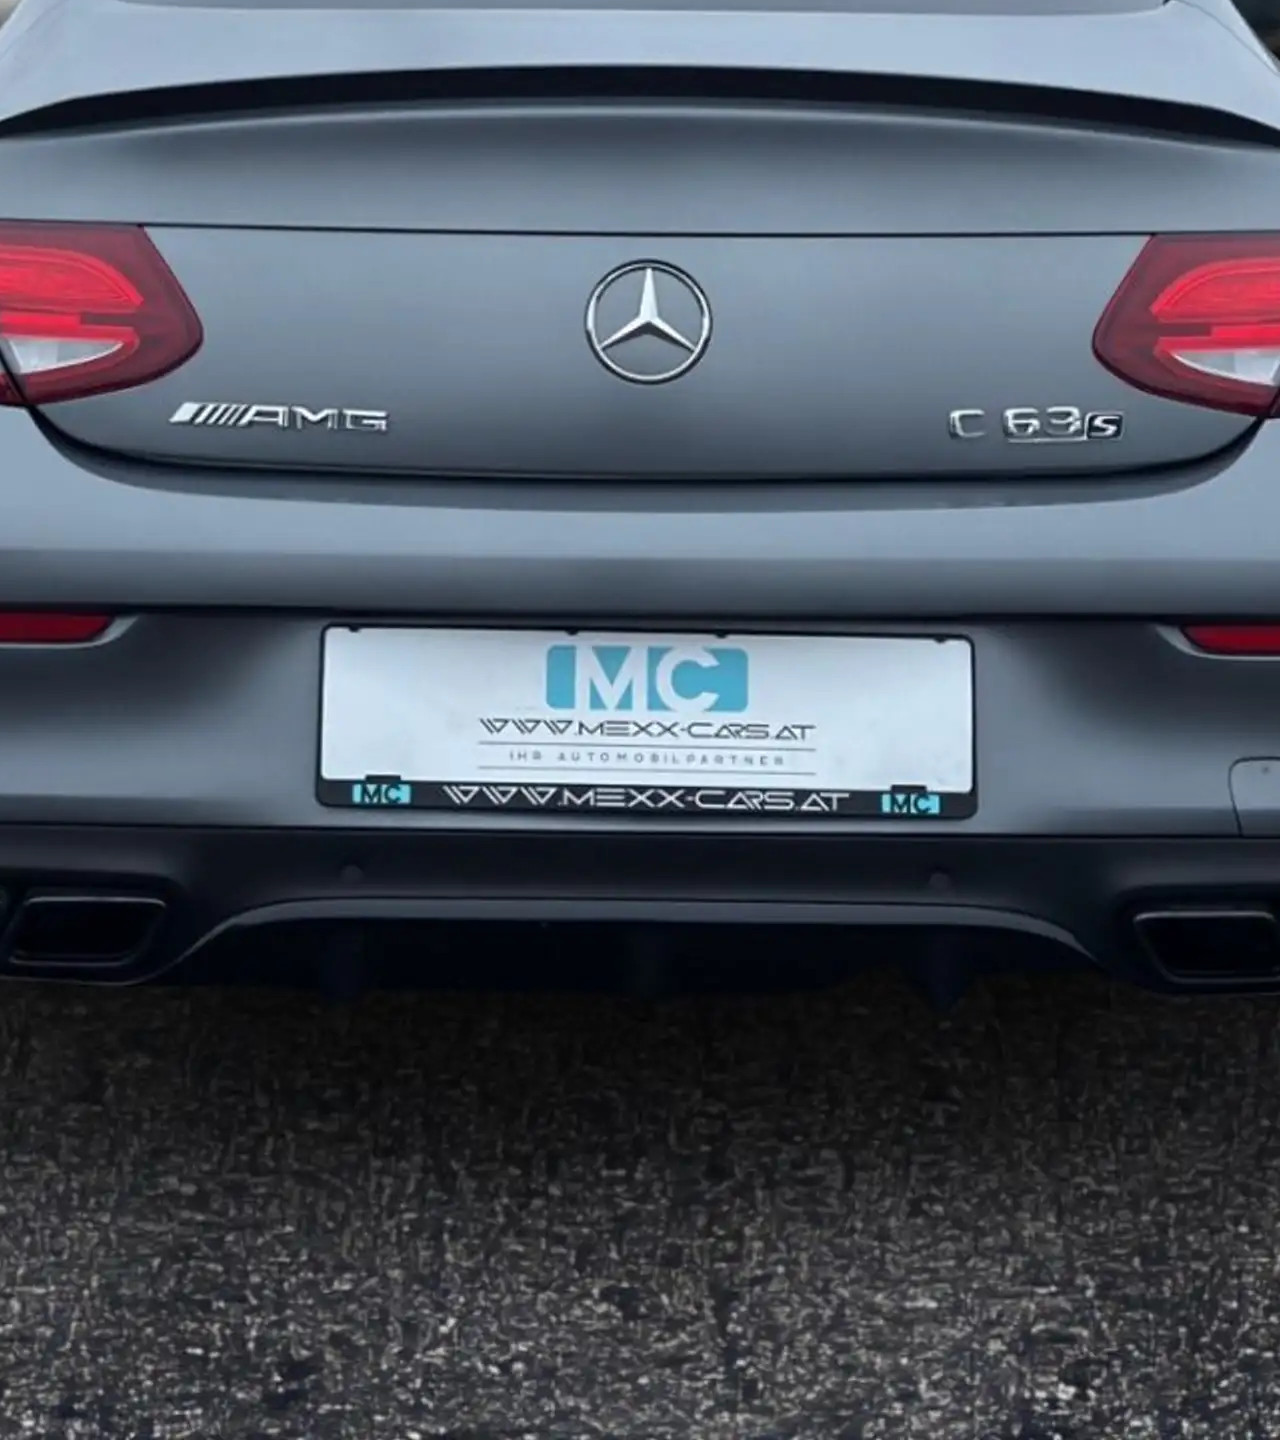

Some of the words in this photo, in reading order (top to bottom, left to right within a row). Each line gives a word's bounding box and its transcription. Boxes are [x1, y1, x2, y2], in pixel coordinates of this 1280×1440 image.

[235, 404, 390, 431] AMG
[949, 408, 986, 438] C
[478, 716, 817, 741] WWW.MEXX-CARS.AT
[441, 784, 851, 813] WWW.MEXX-CARS.AT
